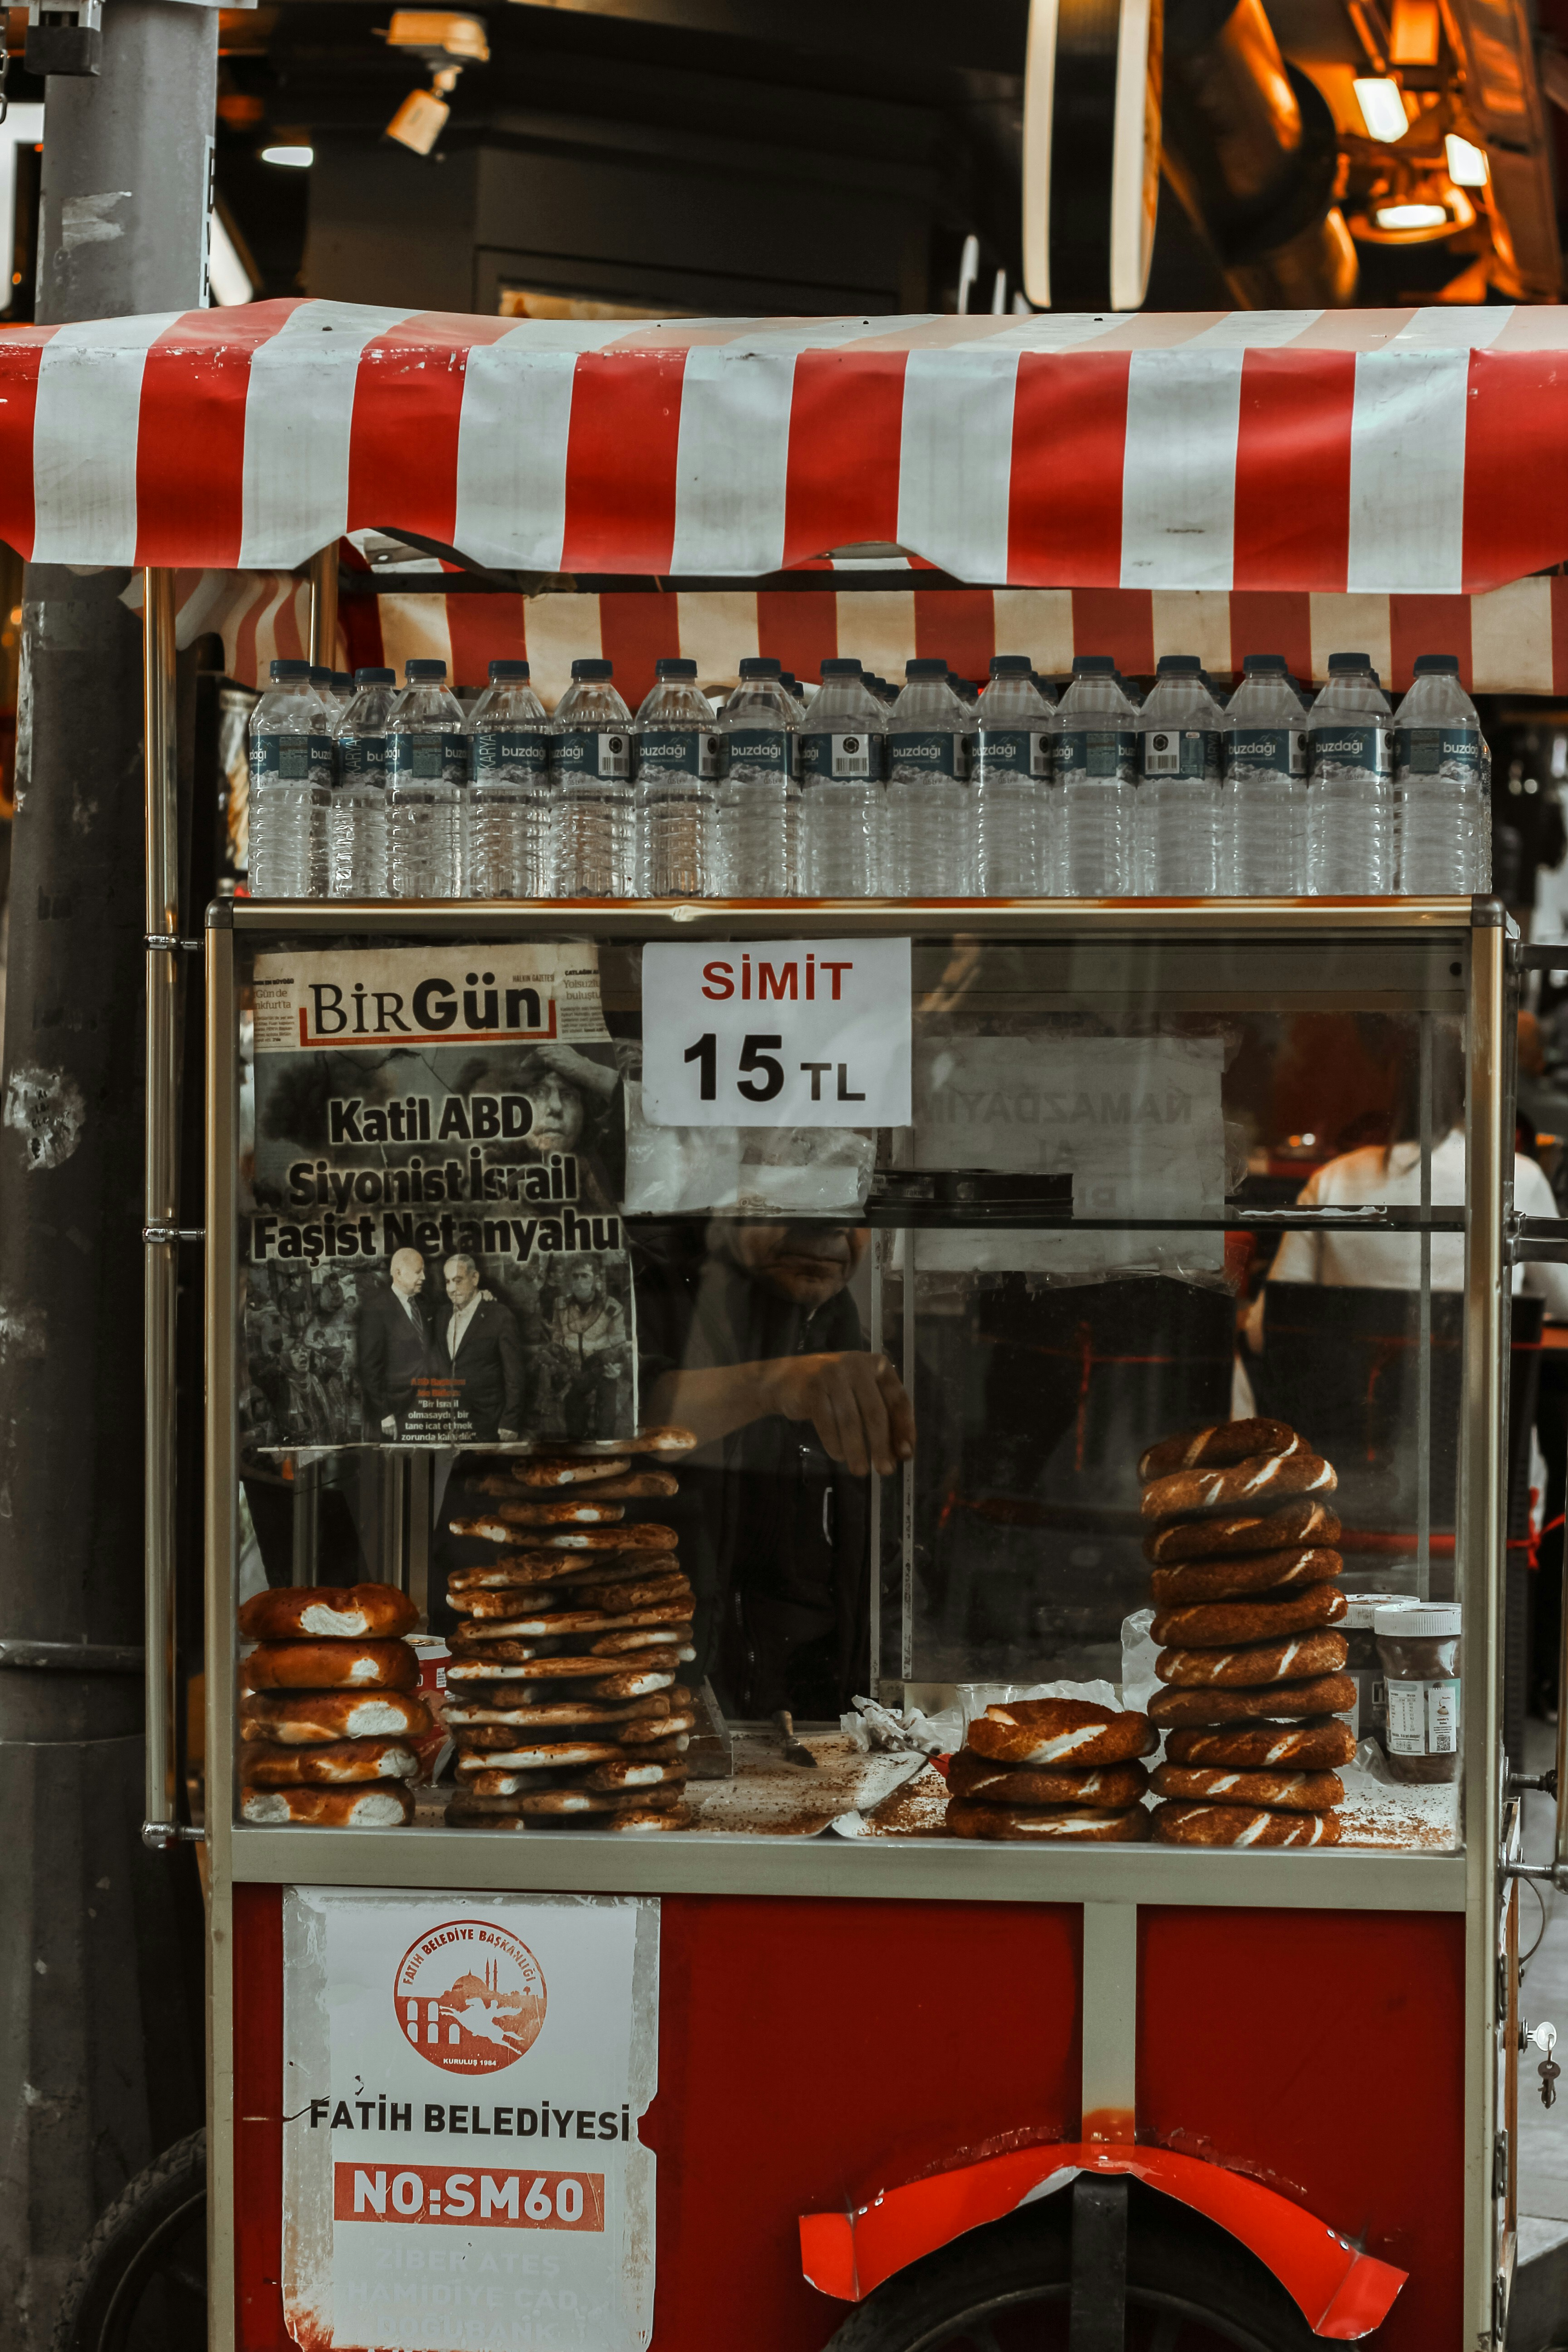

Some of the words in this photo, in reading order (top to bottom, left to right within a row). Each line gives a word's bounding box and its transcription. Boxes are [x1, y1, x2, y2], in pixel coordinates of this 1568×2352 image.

[640, 745, 686, 758] buzdağı
[731, 744, 781, 758] buzdağı
[893, 745, 941, 759] buzdağı
[972, 745, 1016, 758] buzdağı
[1229, 742, 1276, 756] buzdağı
[1316, 740, 1363, 754] buzdağı
[702, 954, 853, 1000] SİMİT
[684, 1033, 784, 1102] 15
[800, 1063, 866, 1101] TL
[331, 1096, 430, 1143] Katil
[438, 1096, 534, 1140] ABD
[288, 1157, 462, 1214] Siyonist
[469, 1146, 577, 1201] İsrail
[254, 1212, 377, 1266] Faşist
[383, 1209, 619, 1262] Netanyahu
[403, 1953, 424, 1985] FATİH
[421, 1927, 474, 1956] BELEDİYE
[479, 1930, 536, 1982] BAŞKANLIĞI
[310, 2094, 412, 2132] FATİH
[424, 2101, 630, 2141] BELEDİYESİ
[353, 2170, 584, 2222] NO:SM60
[348, 2278, 504, 2307] HAMİDİYE
[377, 2313, 559, 2342] DOĞUBANK
